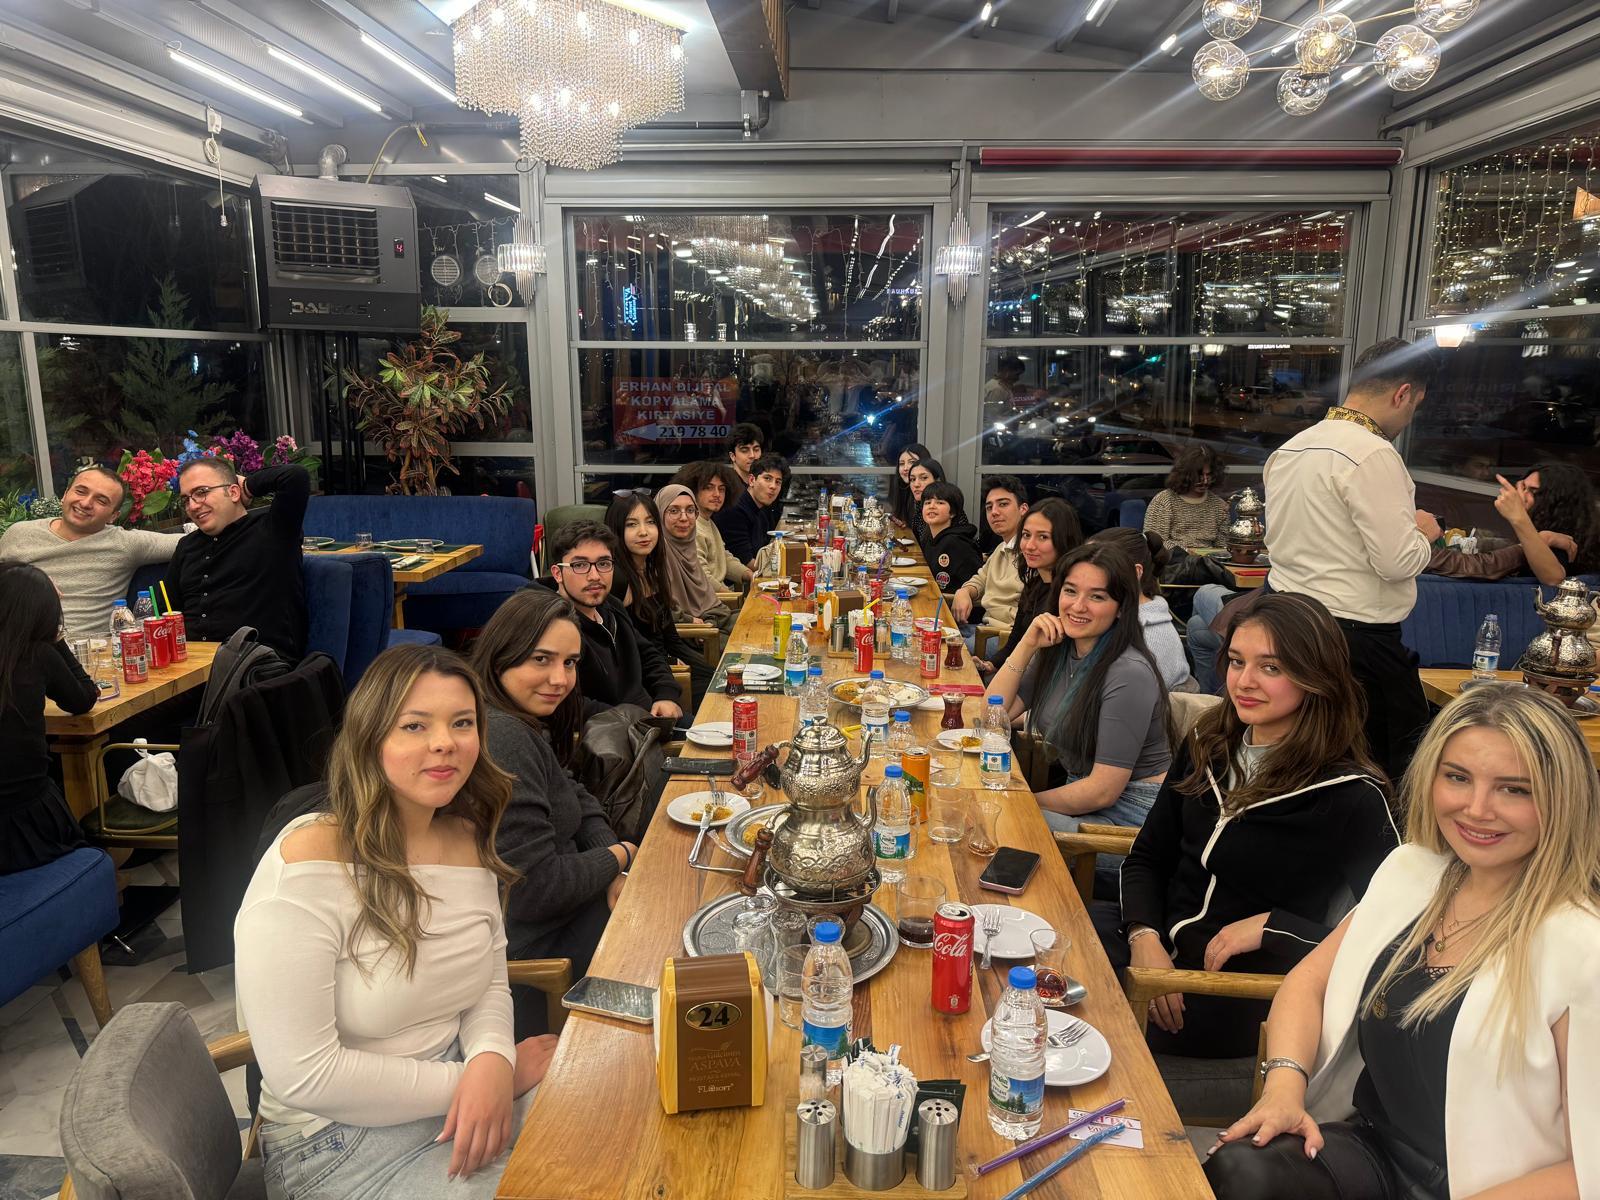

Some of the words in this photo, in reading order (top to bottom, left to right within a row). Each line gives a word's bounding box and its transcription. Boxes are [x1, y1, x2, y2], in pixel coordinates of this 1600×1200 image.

[396, 244, 404, 253] 4
[619, 381, 672, 392] ERHAN
[630, 395, 722, 407] KOPYALAMA
[659, 426, 685, 438] 219
[690, 426, 706, 437] 78
[710, 425, 728, 437] 40
[934, 932, 972, 958] Cola
[698, 1006, 730, 1027] 24
[690, 1056, 741, 1072] ASPAVA
